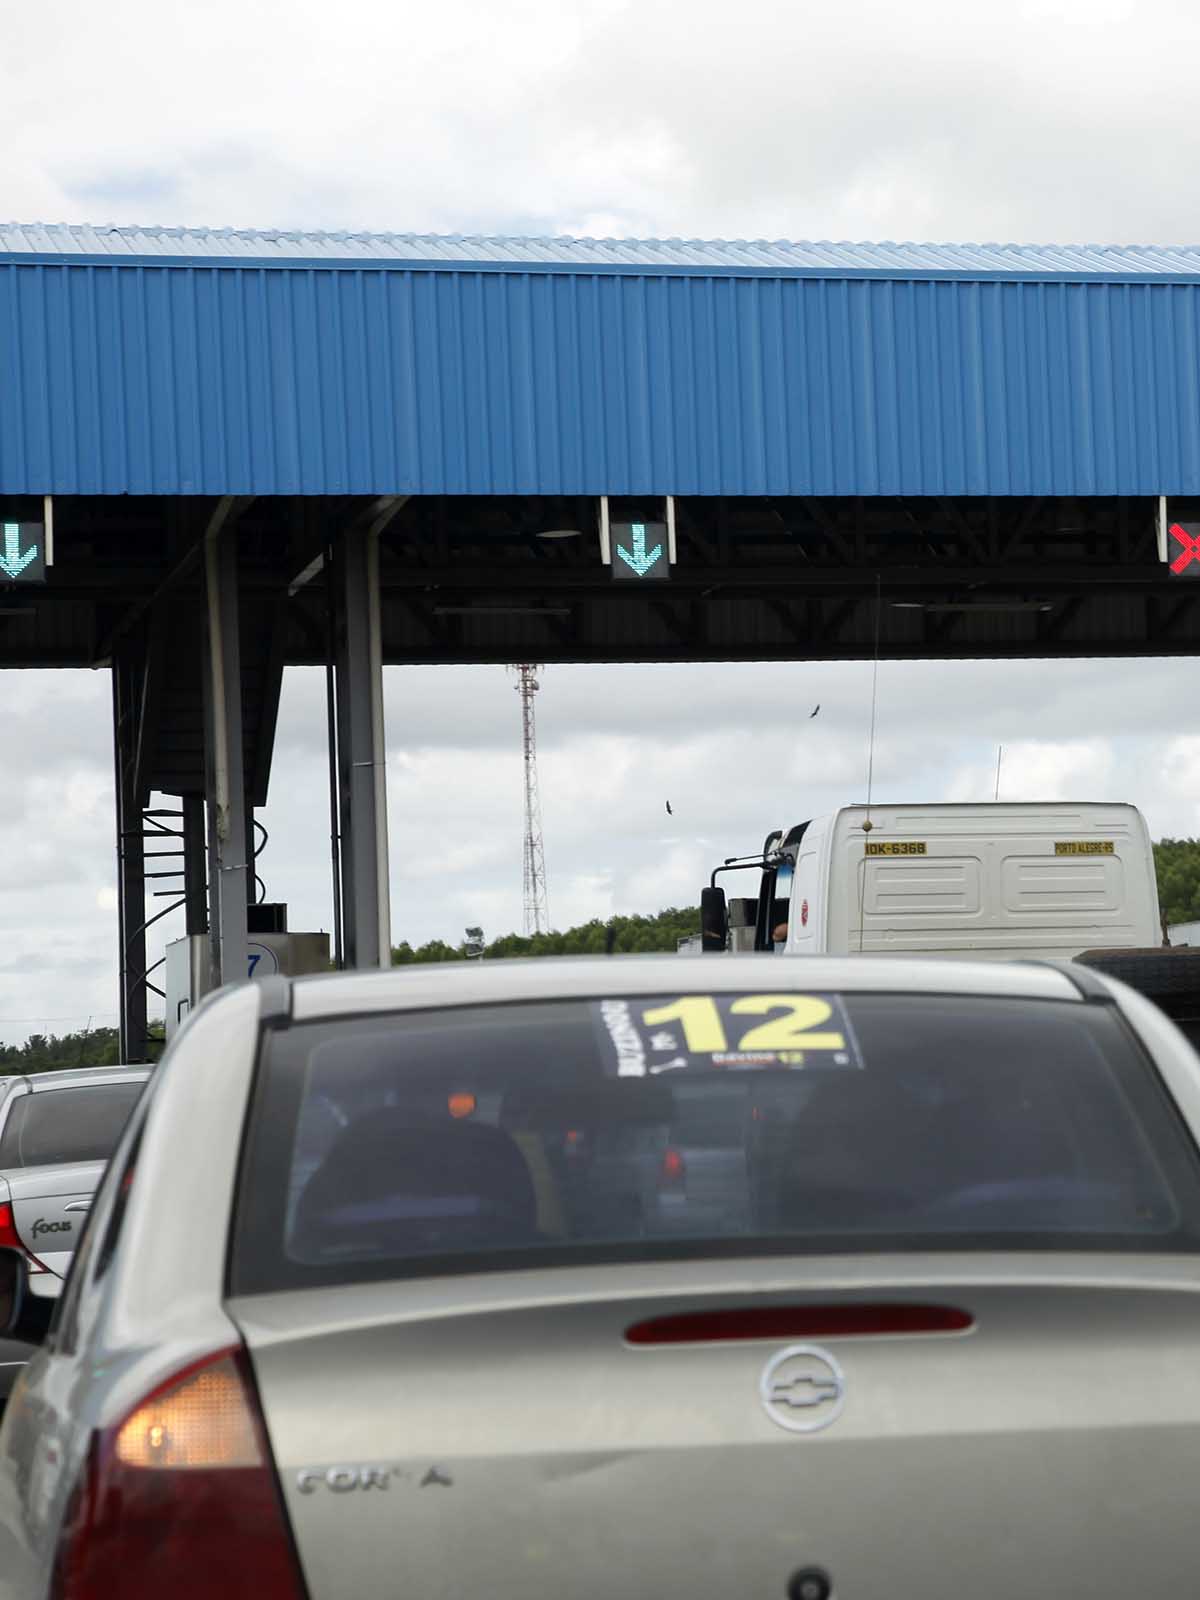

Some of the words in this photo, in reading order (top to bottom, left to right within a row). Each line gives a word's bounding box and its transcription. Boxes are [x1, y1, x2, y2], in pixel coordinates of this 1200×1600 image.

[247, 954, 261, 978] 7
[641, 994, 845, 1054] 12
[297, 1464, 453, 1495] CORA
